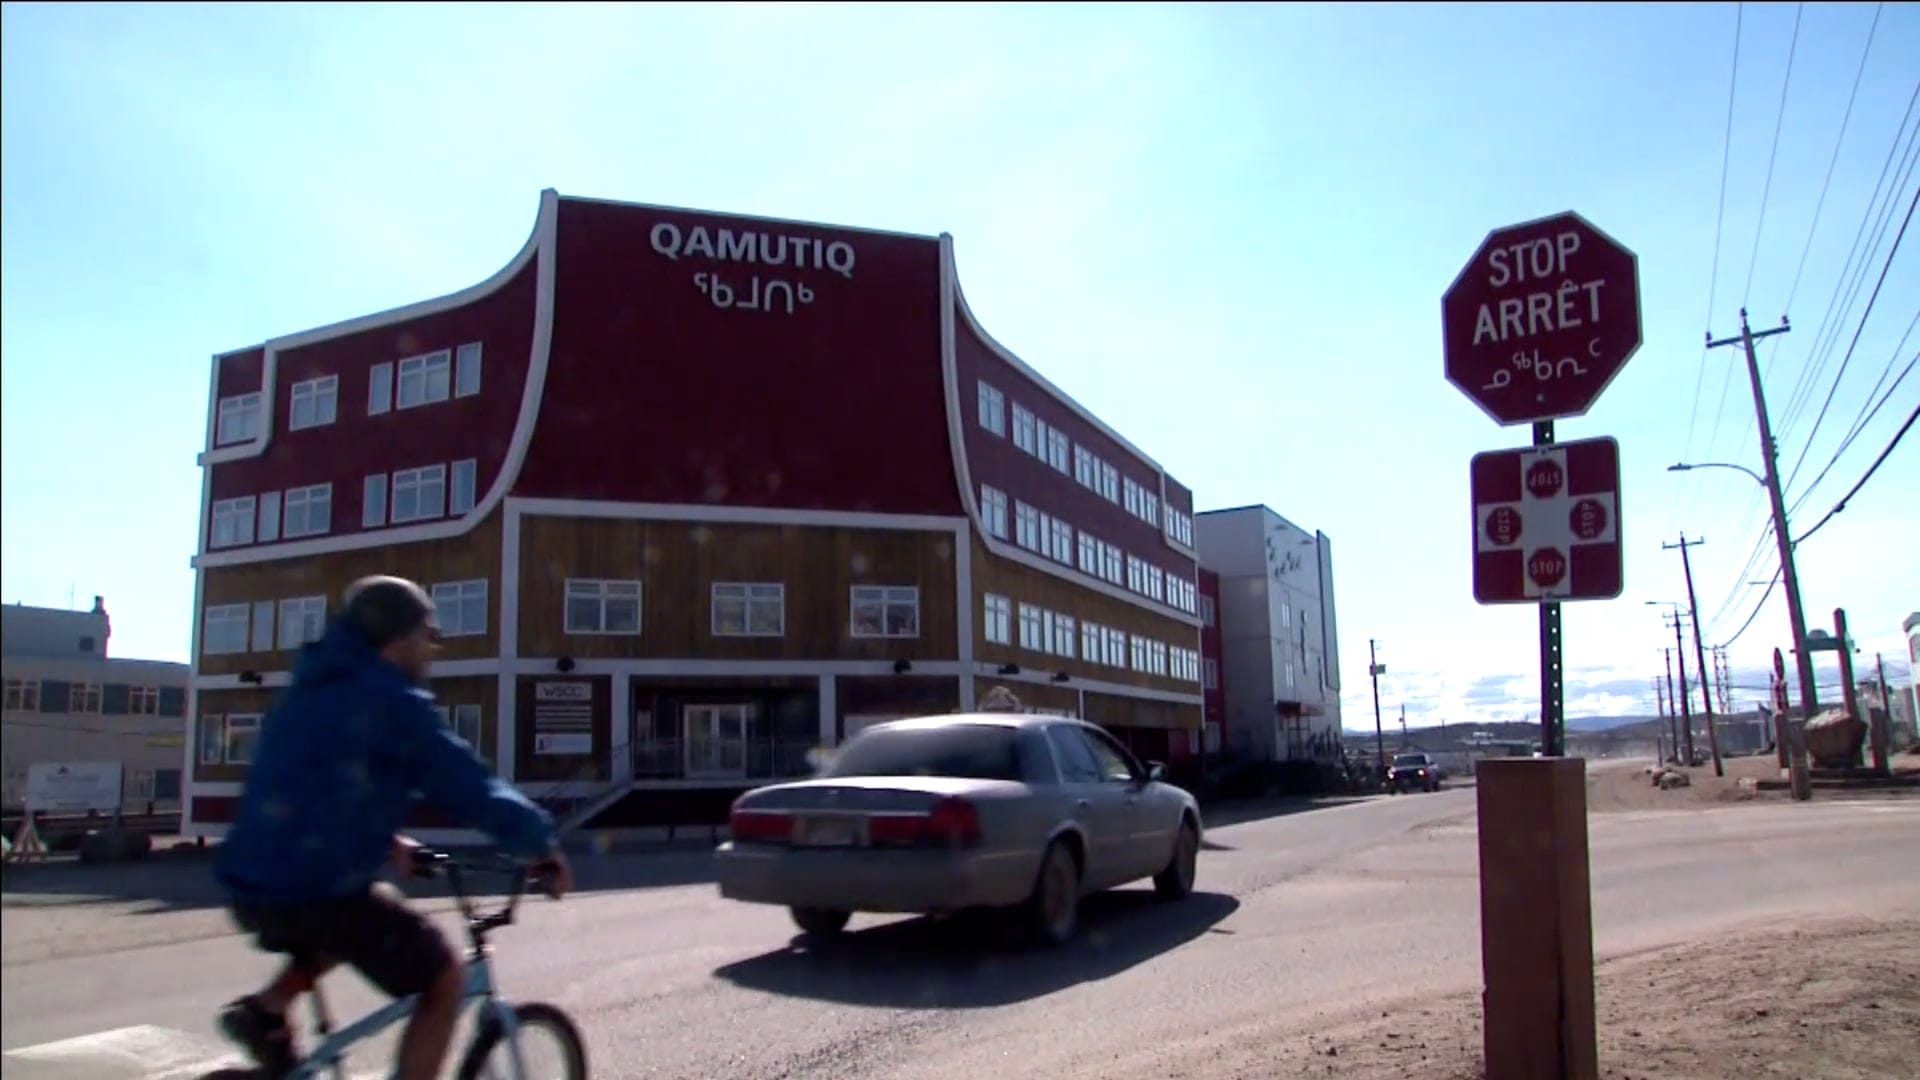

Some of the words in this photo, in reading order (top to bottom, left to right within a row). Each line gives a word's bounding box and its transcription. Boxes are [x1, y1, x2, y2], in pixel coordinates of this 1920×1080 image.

[650, 222, 856, 278] QAMUTIQ
[1488, 231, 1581, 288] STOP
[1472, 279, 1606, 346] ARRÊT
[1529, 471, 1561, 487] STOP
[1497, 510, 1511, 543] STOP
[1581, 503, 1595, 538] STOP
[1530, 560, 1563, 575] STOP
